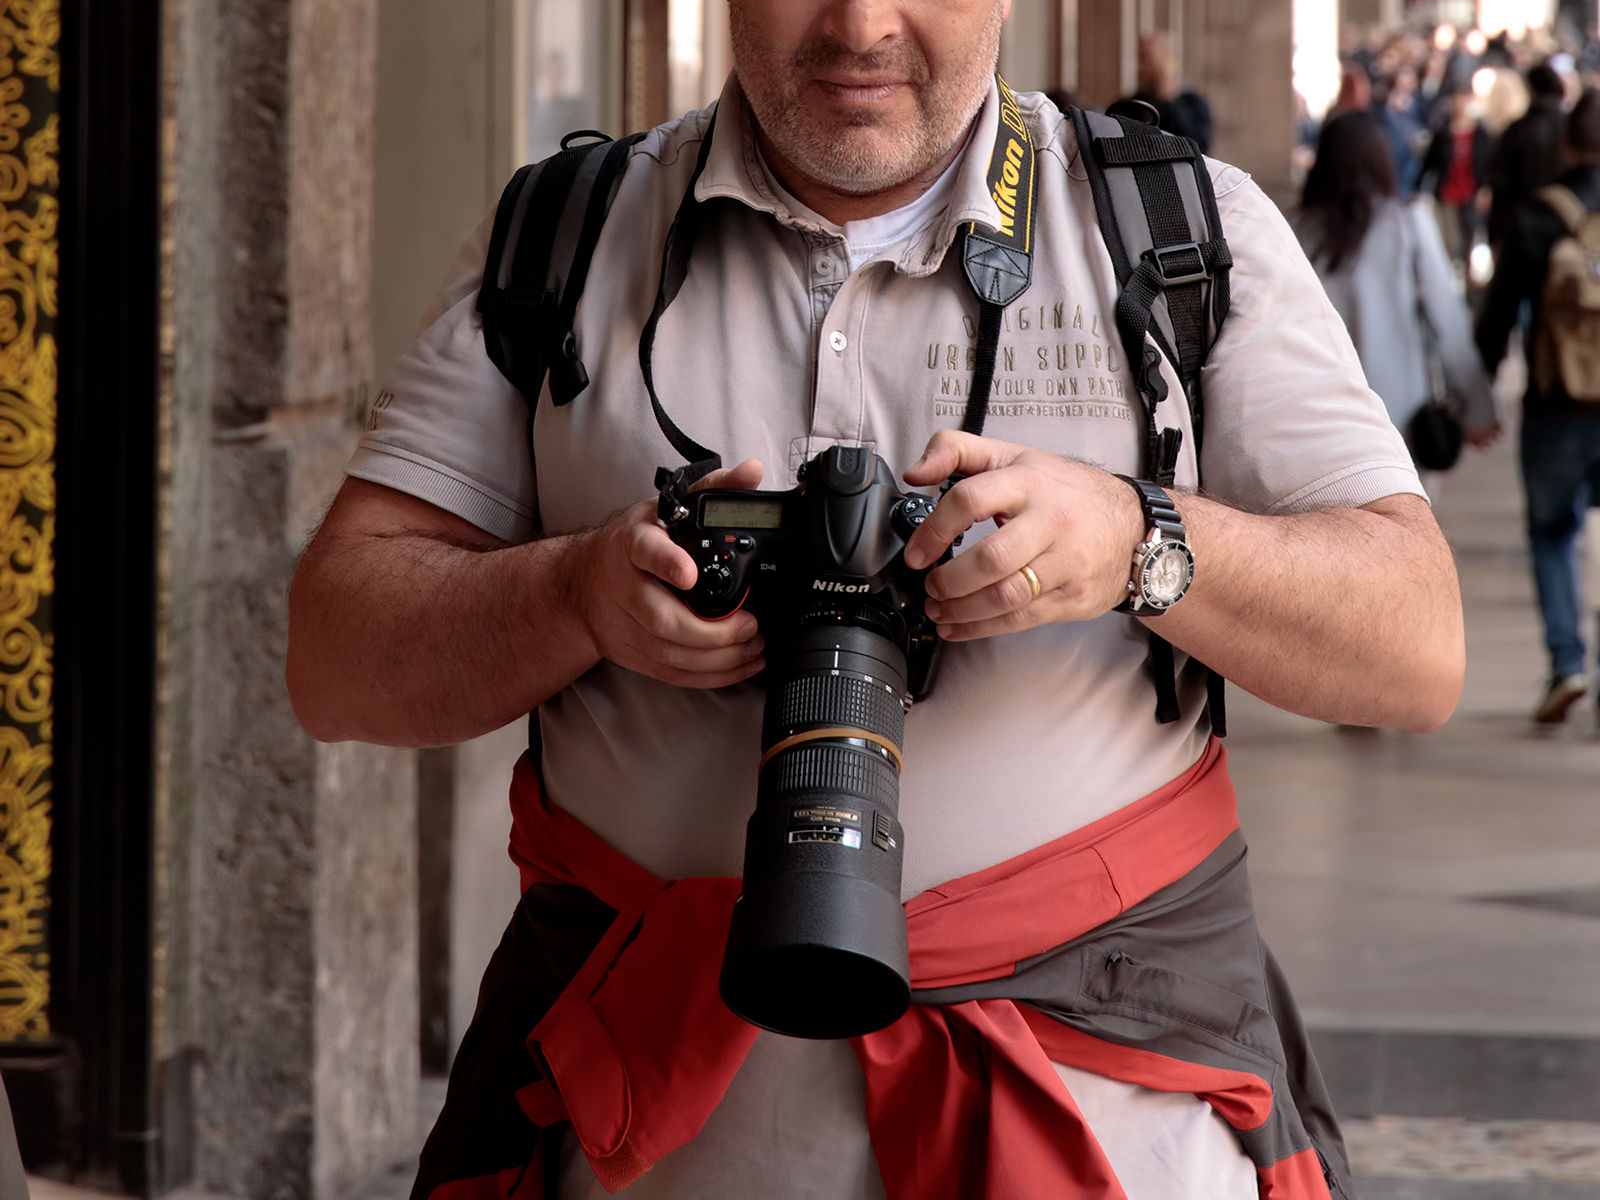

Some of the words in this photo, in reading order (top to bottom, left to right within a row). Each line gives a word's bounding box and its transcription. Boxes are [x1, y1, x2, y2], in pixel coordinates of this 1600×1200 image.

[993, 138, 1024, 237] Nikon
[962, 302, 1100, 339] OIGINAL
[927, 343, 1015, 372] URBN
[940, 377, 970, 396] WAL
[993, 377, 1035, 396] YOUR
[1046, 377, 1078, 396] OWN
[1088, 377, 1125, 398] PATH
[986, 404, 1024, 418] ARMENT
[1037, 404, 1084, 418] DESIGNED
[812, 579, 870, 593] Nikon
